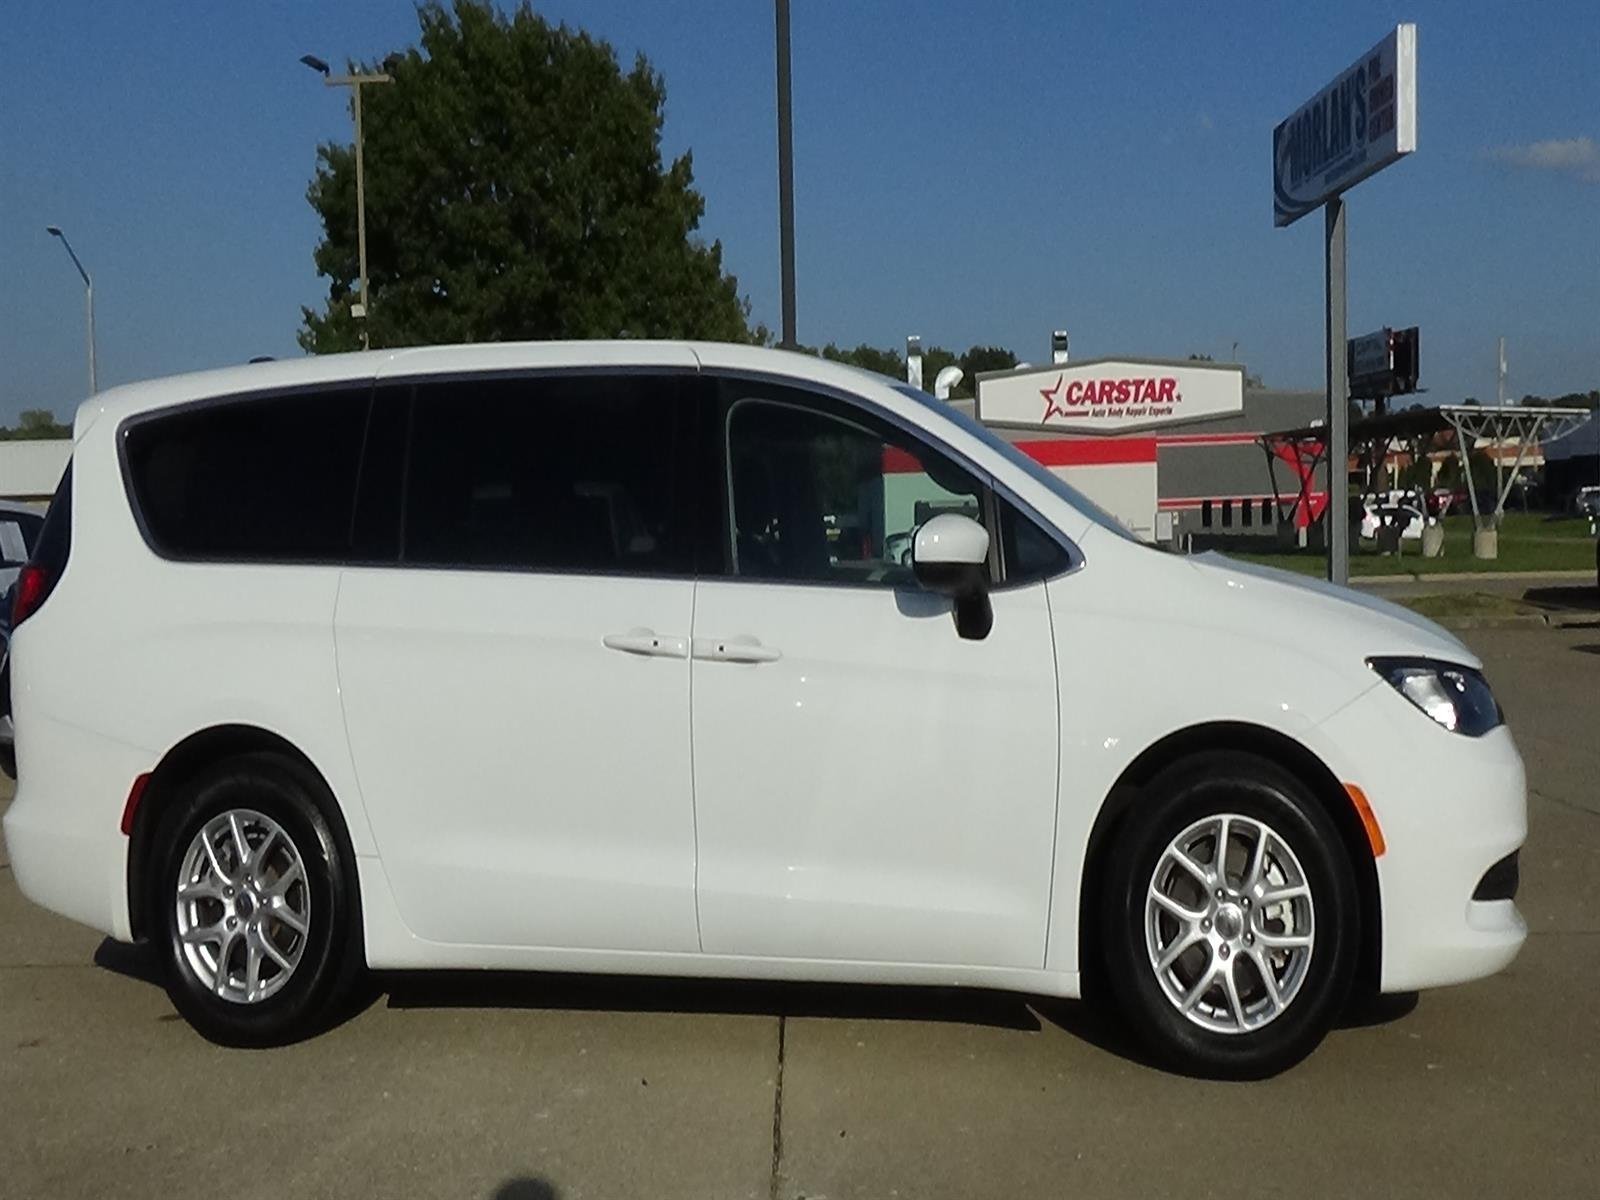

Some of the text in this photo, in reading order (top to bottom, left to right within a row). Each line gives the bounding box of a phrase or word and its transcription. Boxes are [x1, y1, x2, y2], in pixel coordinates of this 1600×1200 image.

[1066, 378, 1177, 406] CARSTAR
[1091, 407, 1106, 417] Auto
[1108, 407, 1123, 418] Body
[1126, 406, 1146, 418] Repair
